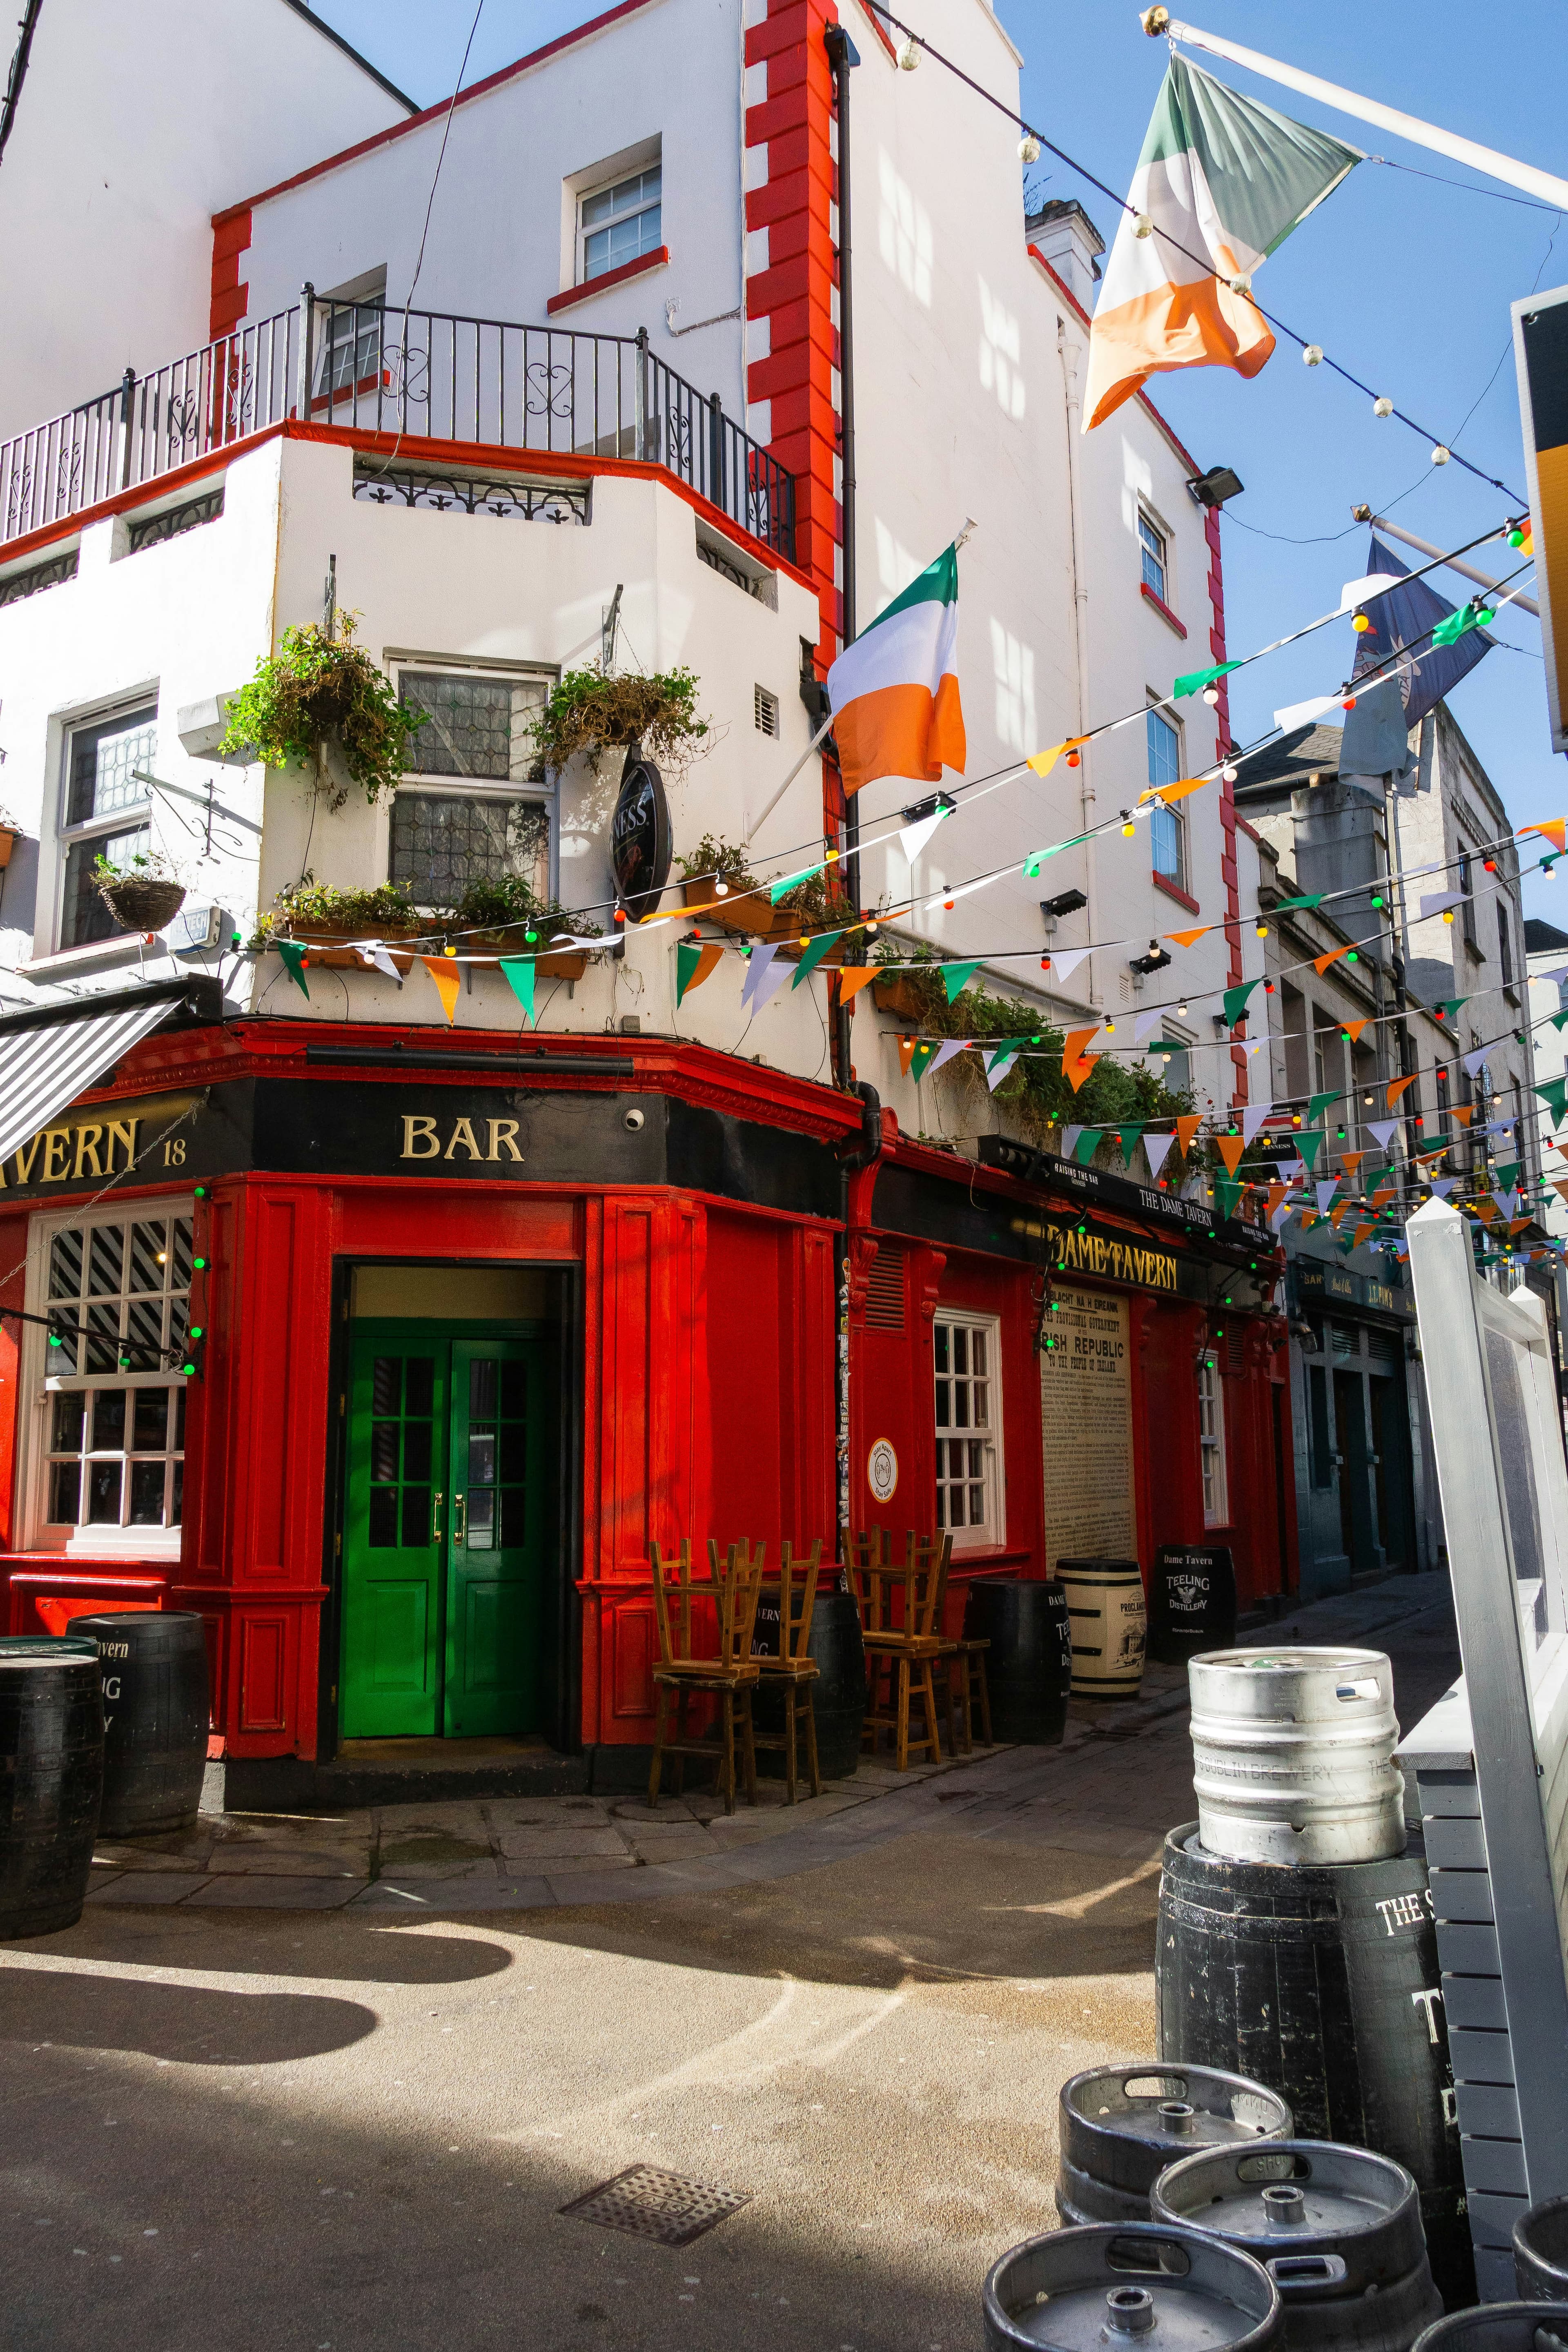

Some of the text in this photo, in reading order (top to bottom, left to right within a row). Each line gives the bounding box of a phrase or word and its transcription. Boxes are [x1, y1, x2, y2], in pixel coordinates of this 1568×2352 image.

[400, 1116, 525, 1161] BAR
[0, 1118, 186, 1188] VERN 18
[1055, 1163, 1098, 1185] RAISING THE BAR
[1139, 1189, 1212, 1227] THE DAME TAVERN
[1047, 1225, 1177, 1291] DAME TAVERN
[1305, 1275, 1322, 1284] BAR
[1076, 1296, 1085, 1307] NA
[1088, 1298, 1092, 1307] H
[1056, 1311, 1086, 1327] PROVISIONAL
[1089, 1317, 1119, 1333] GOVERNMENT
[1042, 1332, 1123, 1358] RISH REPUBLIC
[1049, 1354, 1055, 1366] TO
[1058, 1355, 1067, 1368] THE
[1071, 1356, 1086, 1370] PEOPLE
[1089, 1359, 1094, 1371] OF
[882, 1444, 892, 1456] Apart
[875, 1487, 883, 1498] Stay
[1164, 1555, 1212, 1565] Dame Tavern
[1166, 1575, 1209, 1590] TEELING
[1169, 1599, 1207, 1610] DISTILLERY
[1376, 1894, 1425, 1936] THE
